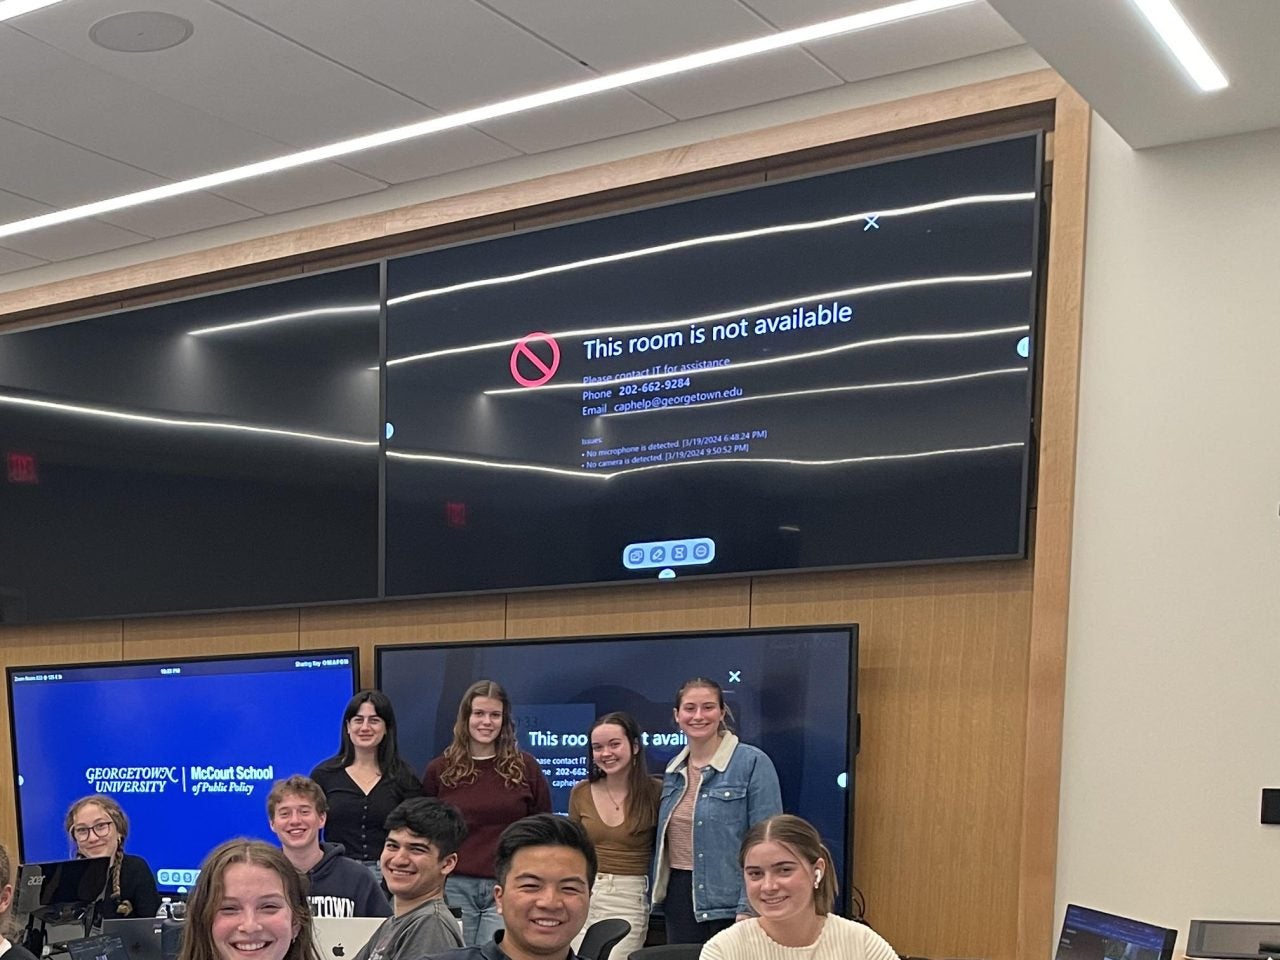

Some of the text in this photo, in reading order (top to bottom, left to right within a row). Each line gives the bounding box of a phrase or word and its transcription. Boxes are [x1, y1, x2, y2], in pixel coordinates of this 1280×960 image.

[583, 302, 853, 360] This room is not available
[582, 357, 731, 385] Please contact IT for assistance
[582, 377, 691, 401] Phone 202-662-9284
[582, 387, 743, 416] Email caphelp@georgetown.edu
[586, 450, 597, 458] No
[598, 446, 639, 458] microphone
[586, 461, 597, 469] No
[598, 458, 623, 468] camera
[529, 731, 558, 746] This
[562, 735, 588, 746] roo
[552, 757, 579, 766] contact
[580, 757, 587, 765] IT
[86, 765, 274, 784] GEORGETOWN McCourt School
[555, 768, 589, 777] 202-662-
[95, 781, 254, 796] UNIVERSITY of Public Policy
[27, 874, 46, 886] acer
